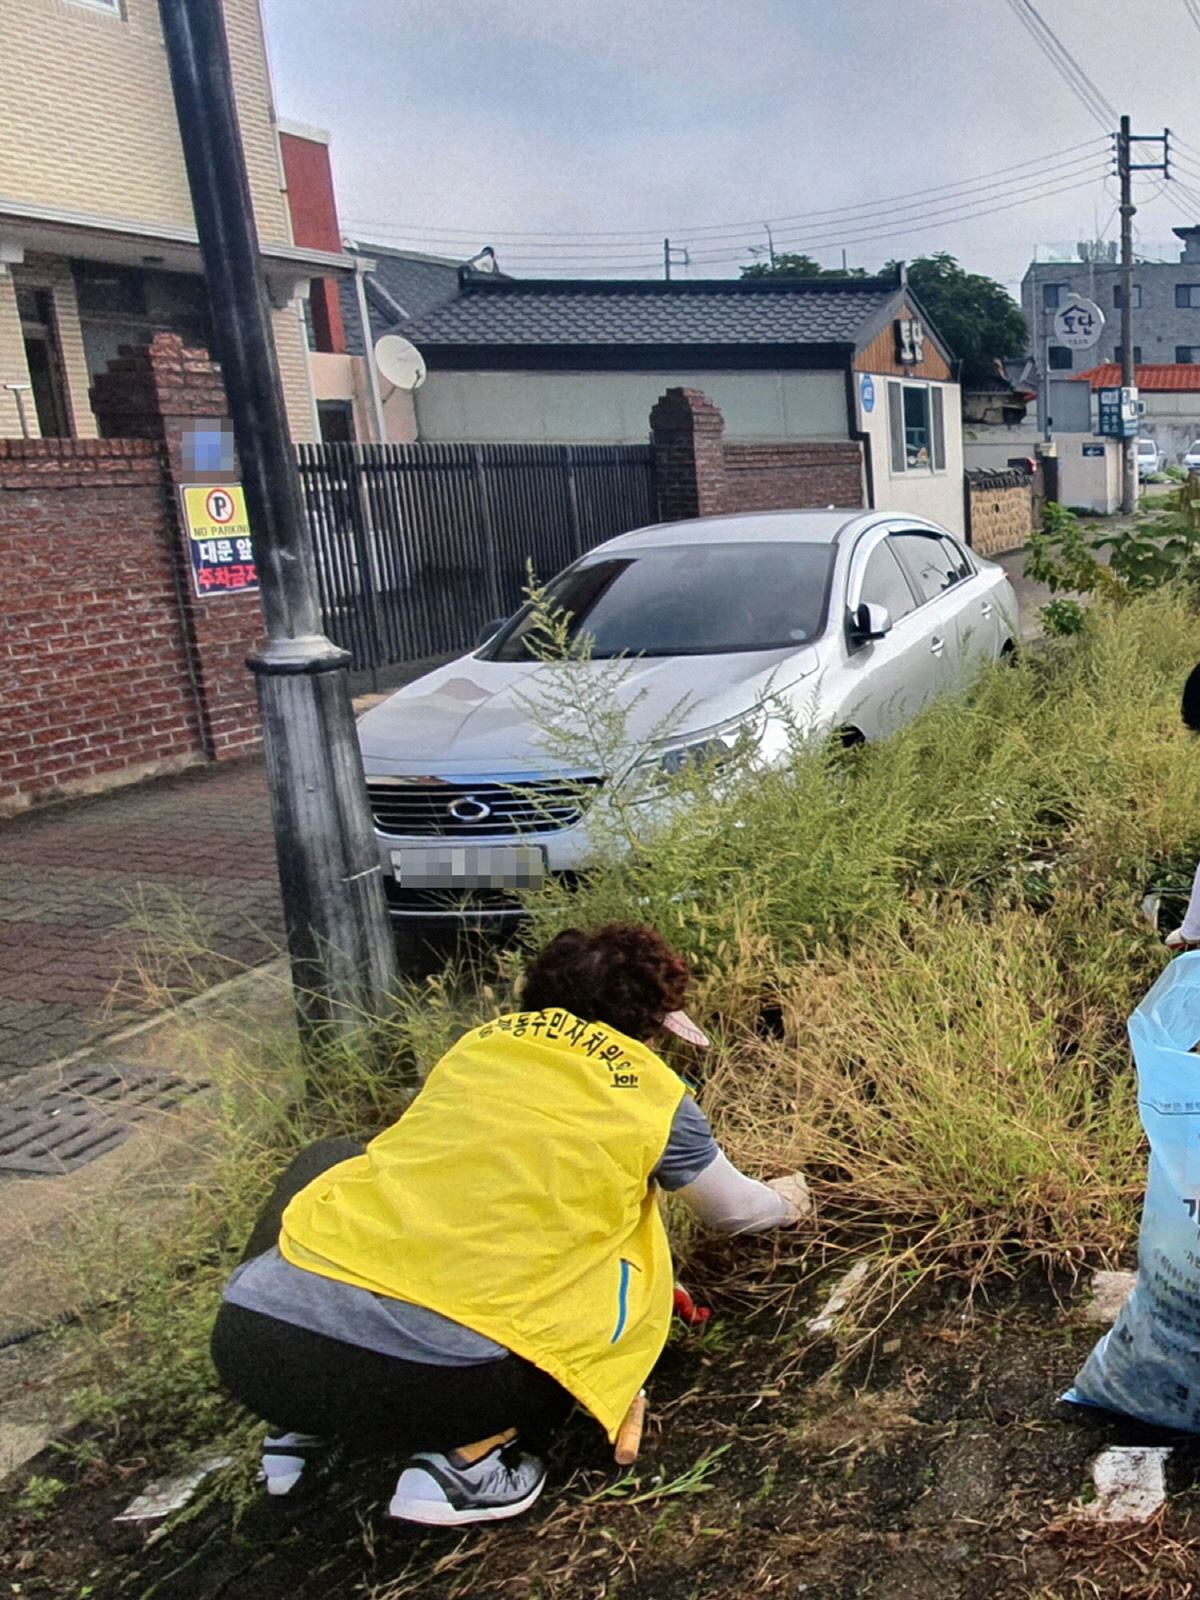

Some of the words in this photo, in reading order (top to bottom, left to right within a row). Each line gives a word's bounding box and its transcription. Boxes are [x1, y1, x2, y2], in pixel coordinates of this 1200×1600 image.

[194, 526, 208, 536] NO
[211, 525, 250, 536] PARKIN
[199, 540, 233, 564] 대문
